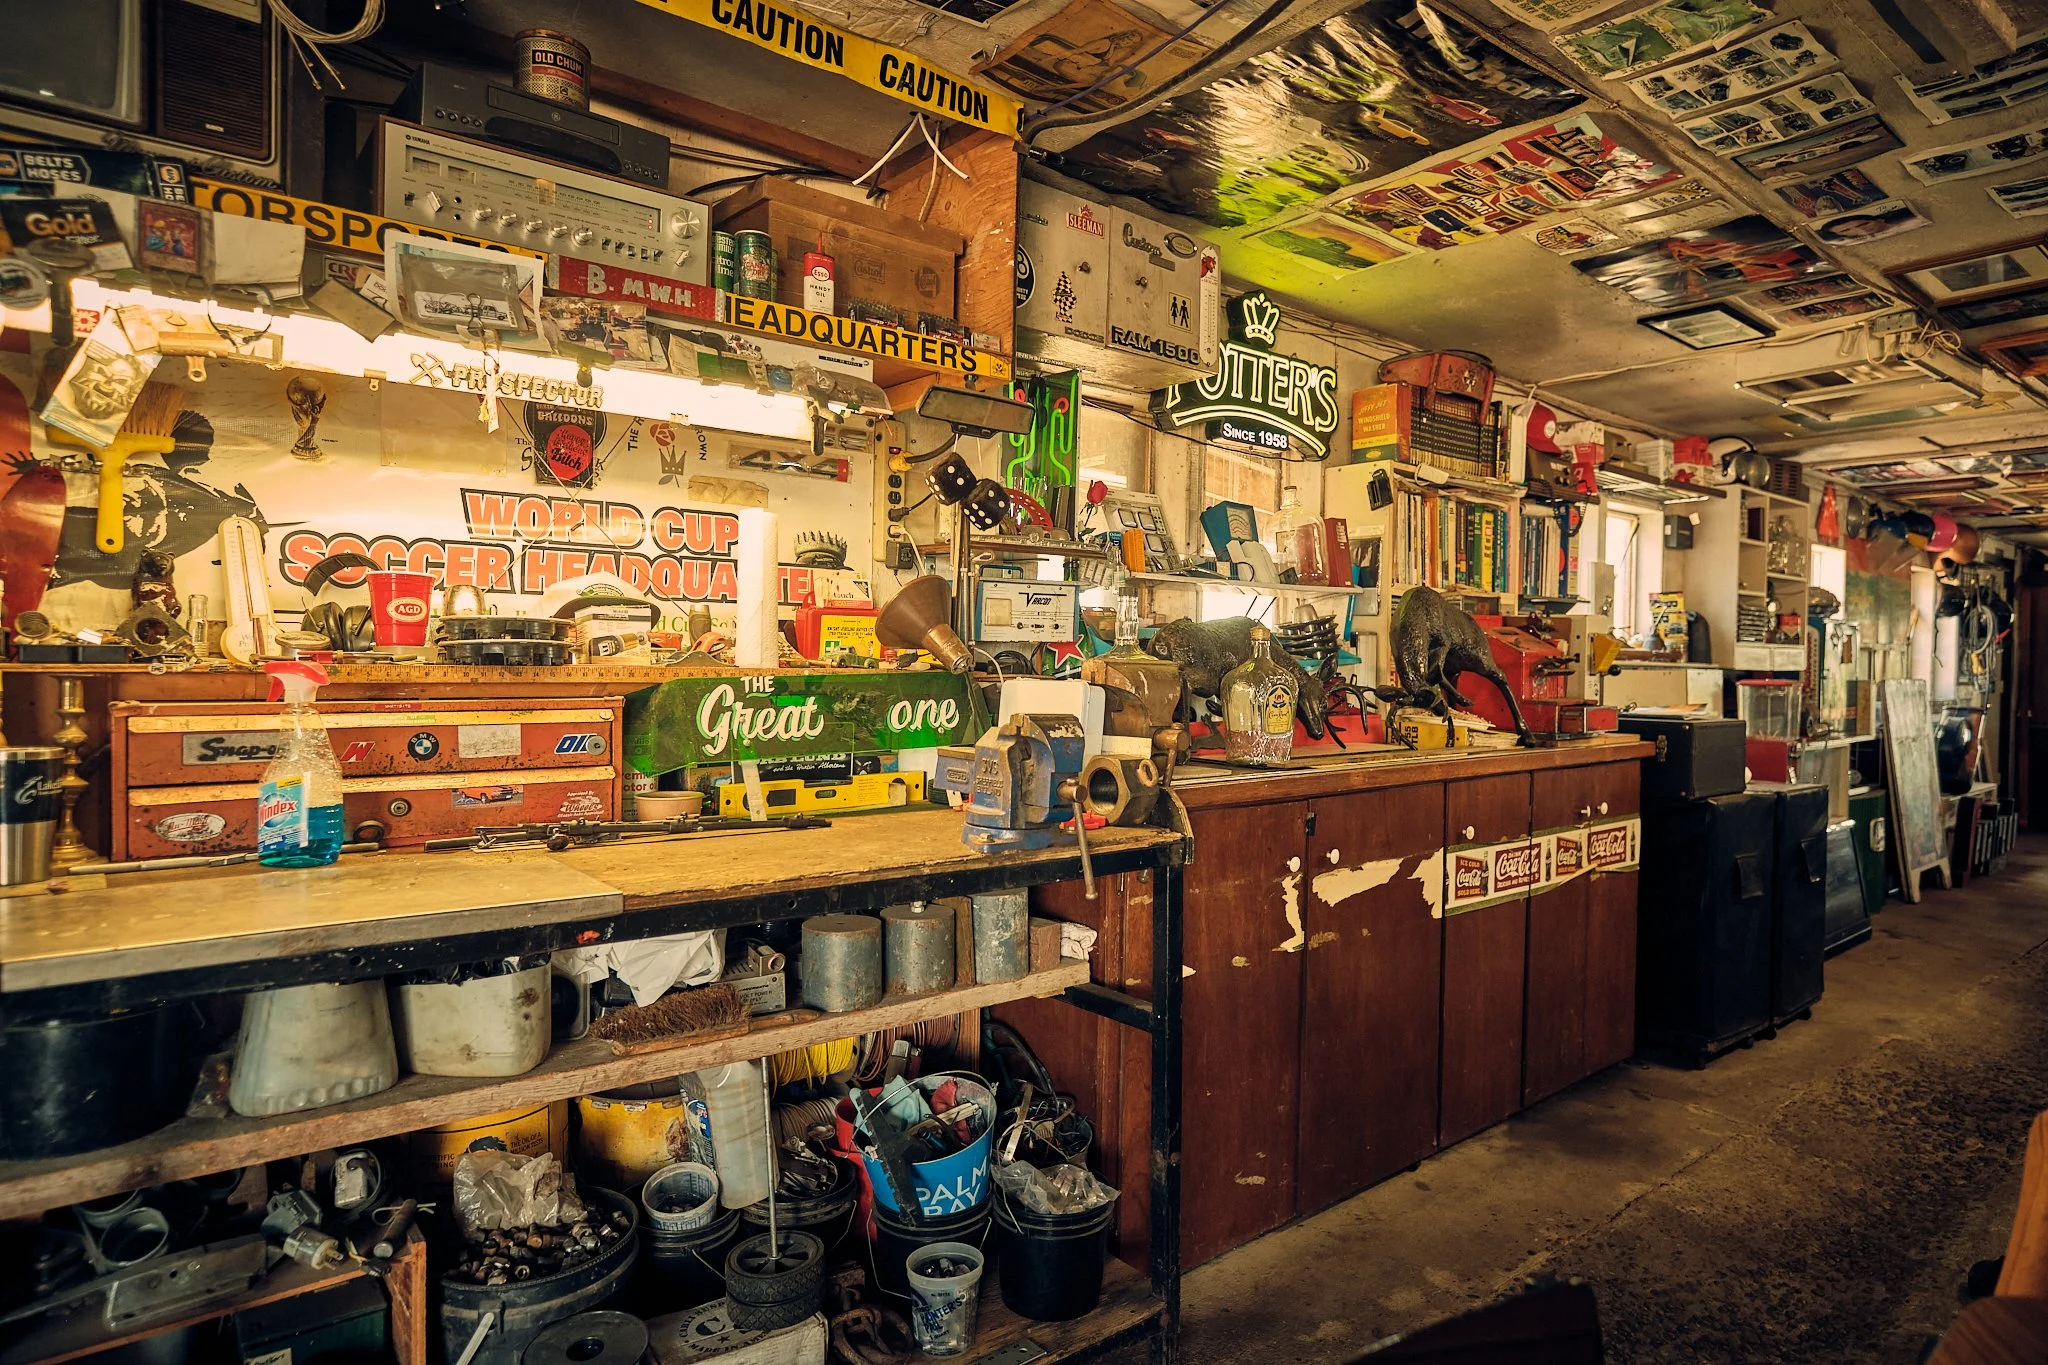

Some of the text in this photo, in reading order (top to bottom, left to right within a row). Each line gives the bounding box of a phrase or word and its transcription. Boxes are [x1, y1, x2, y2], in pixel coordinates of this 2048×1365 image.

[711, 0, 844, 67] CAUTION
[535, 52, 554, 64] OLD
[556, 55, 582, 74] CHUM
[879, 52, 989, 123] CAUTION
[412, 136, 430, 145] YAMAHA
[24, 153, 74, 168] BELTS
[26, 169, 82, 182] HOSES
[25, 212, 96, 235] Gold
[1069, 215, 1103, 237] SLEEMAN
[1122, 222, 1163, 257] Custom
[810, 284, 830, 292] HANDY
[1112, 326, 1200, 366] RAM 1500
[452, 362, 605, 409] PRSPECTOR
[1166, 341, 1339, 433] OTTER'S
[1358, 413, 1390, 424] WINDSHIELD
[1363, 423, 1386, 432] WASHER
[627, 428, 639, 452] THE
[1259, 430, 1288, 449] 1958
[552, 447, 582, 470] Bitch
[460, 488, 739, 555] WORLD CUP
[279, 530, 516, 595] SOCCER
[398, 605, 421, 614] AGD
[740, 675, 776, 694] THE
[697, 683, 960, 756] Great one
[197, 737, 284, 762] Snap-o
[411, 733, 437, 744] BMW
[1508, 850, 1522, 858] DRINK
[1590, 830, 1626, 860] Coca-Cola
[1469, 860, 1480, 868] COLD
[1496, 848, 1541, 880] Coca-Cola
[1558, 848, 1578, 866] Coca-Cola
[1457, 868, 1481, 888] Coca-Cola
[511, 1140, 520, 1148] THE
[531, 1139, 544, 1148] TESTS
[916, 1155, 987, 1205] PALM
[689, 1344, 720, 1353] MADE
